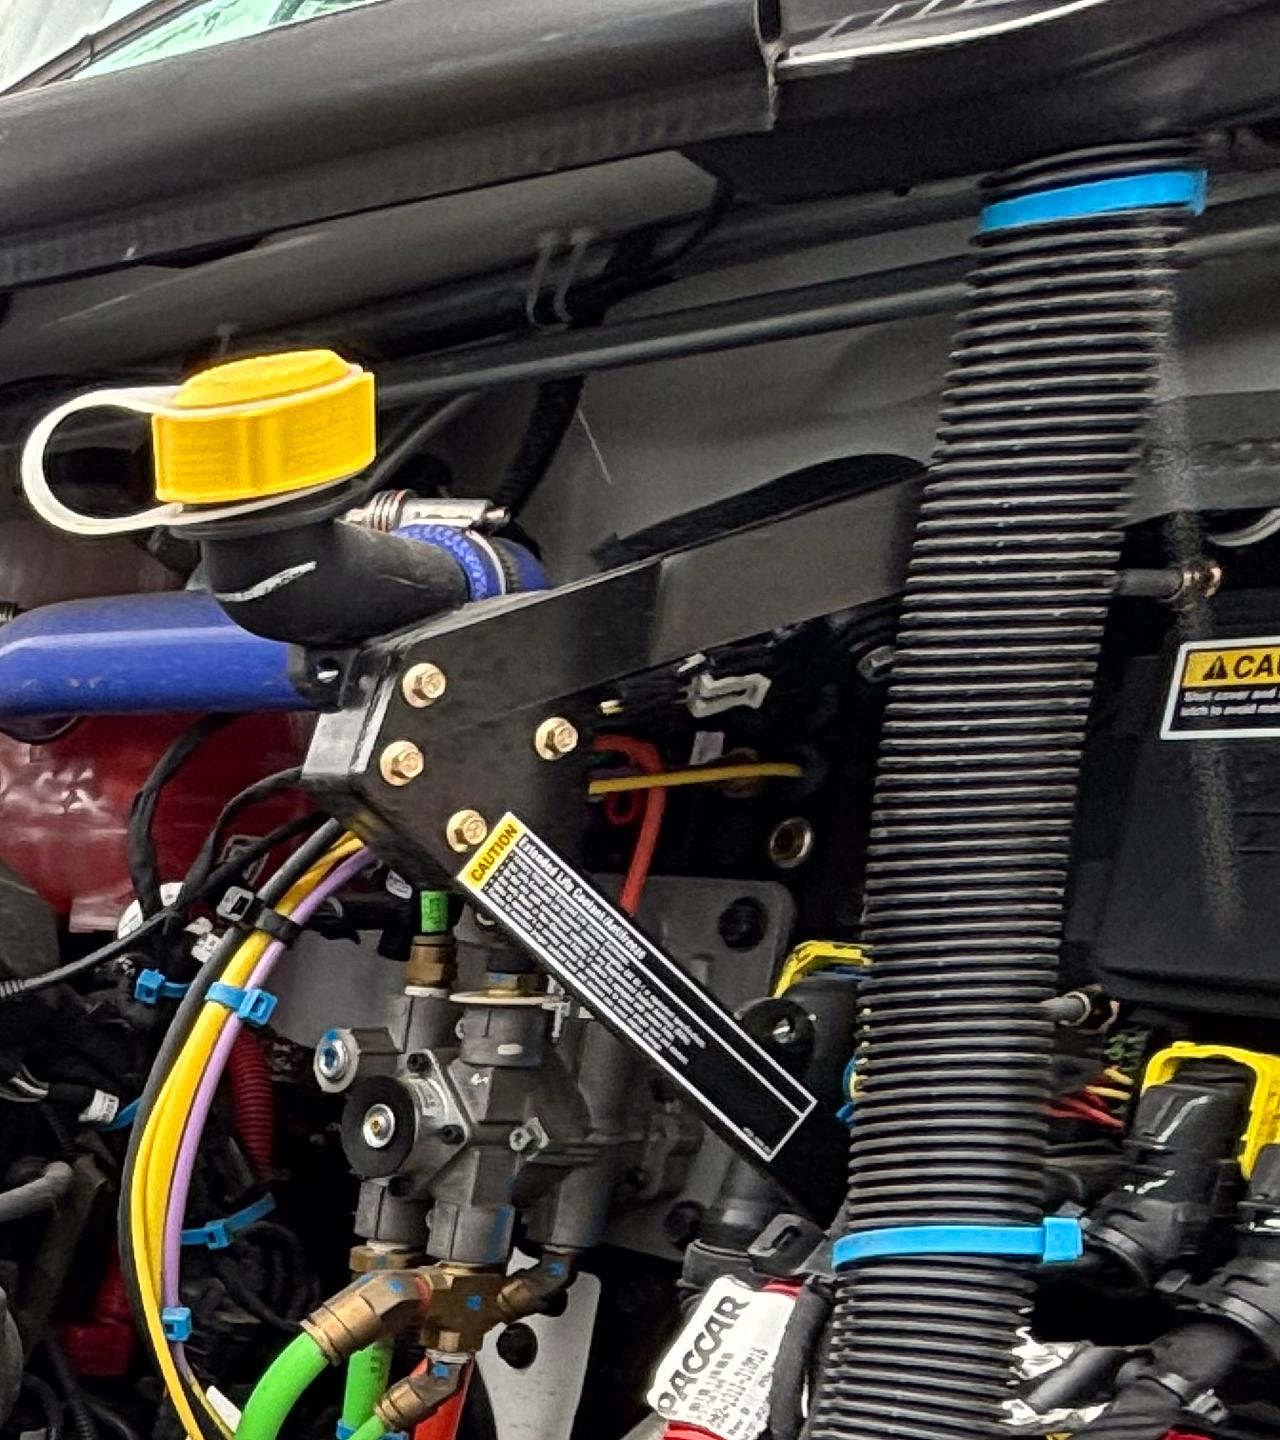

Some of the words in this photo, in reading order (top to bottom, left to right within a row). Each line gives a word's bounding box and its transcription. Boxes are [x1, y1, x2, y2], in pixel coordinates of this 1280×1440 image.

[1233, 654, 1280, 679] CA
[470, 824, 518, 882] CAUTION
[657, 1295, 751, 1417] PACCAR
